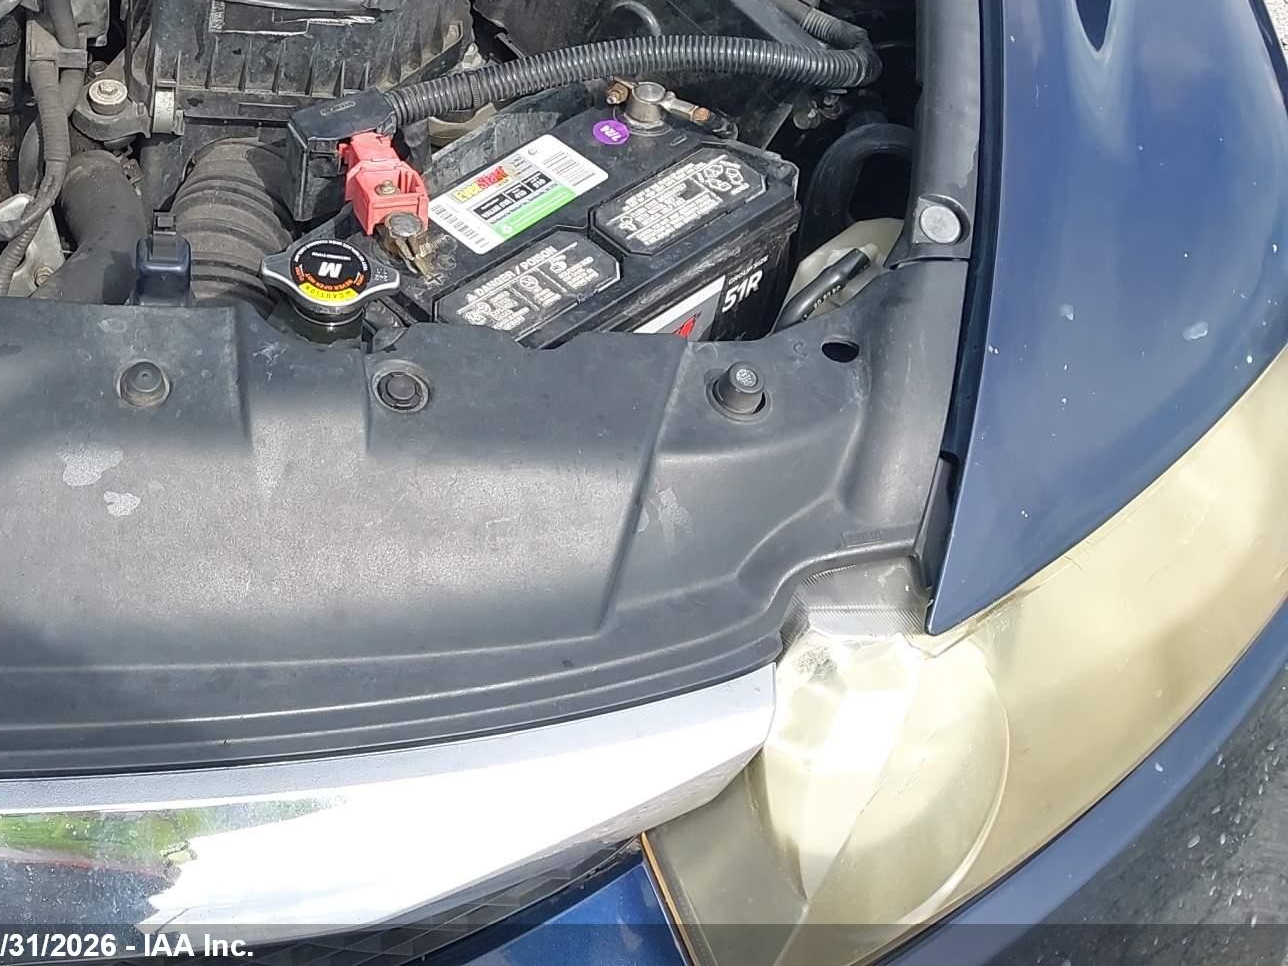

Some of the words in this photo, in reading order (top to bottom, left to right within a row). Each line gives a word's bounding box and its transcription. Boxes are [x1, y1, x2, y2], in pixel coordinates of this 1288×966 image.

[318, 262, 342, 278] M
[475, 270, 517, 295] DANGER
[520, 246, 558, 270] POISON
[306, 285, 344, 299] CAUTION
[721, 269, 764, 314] 51R
